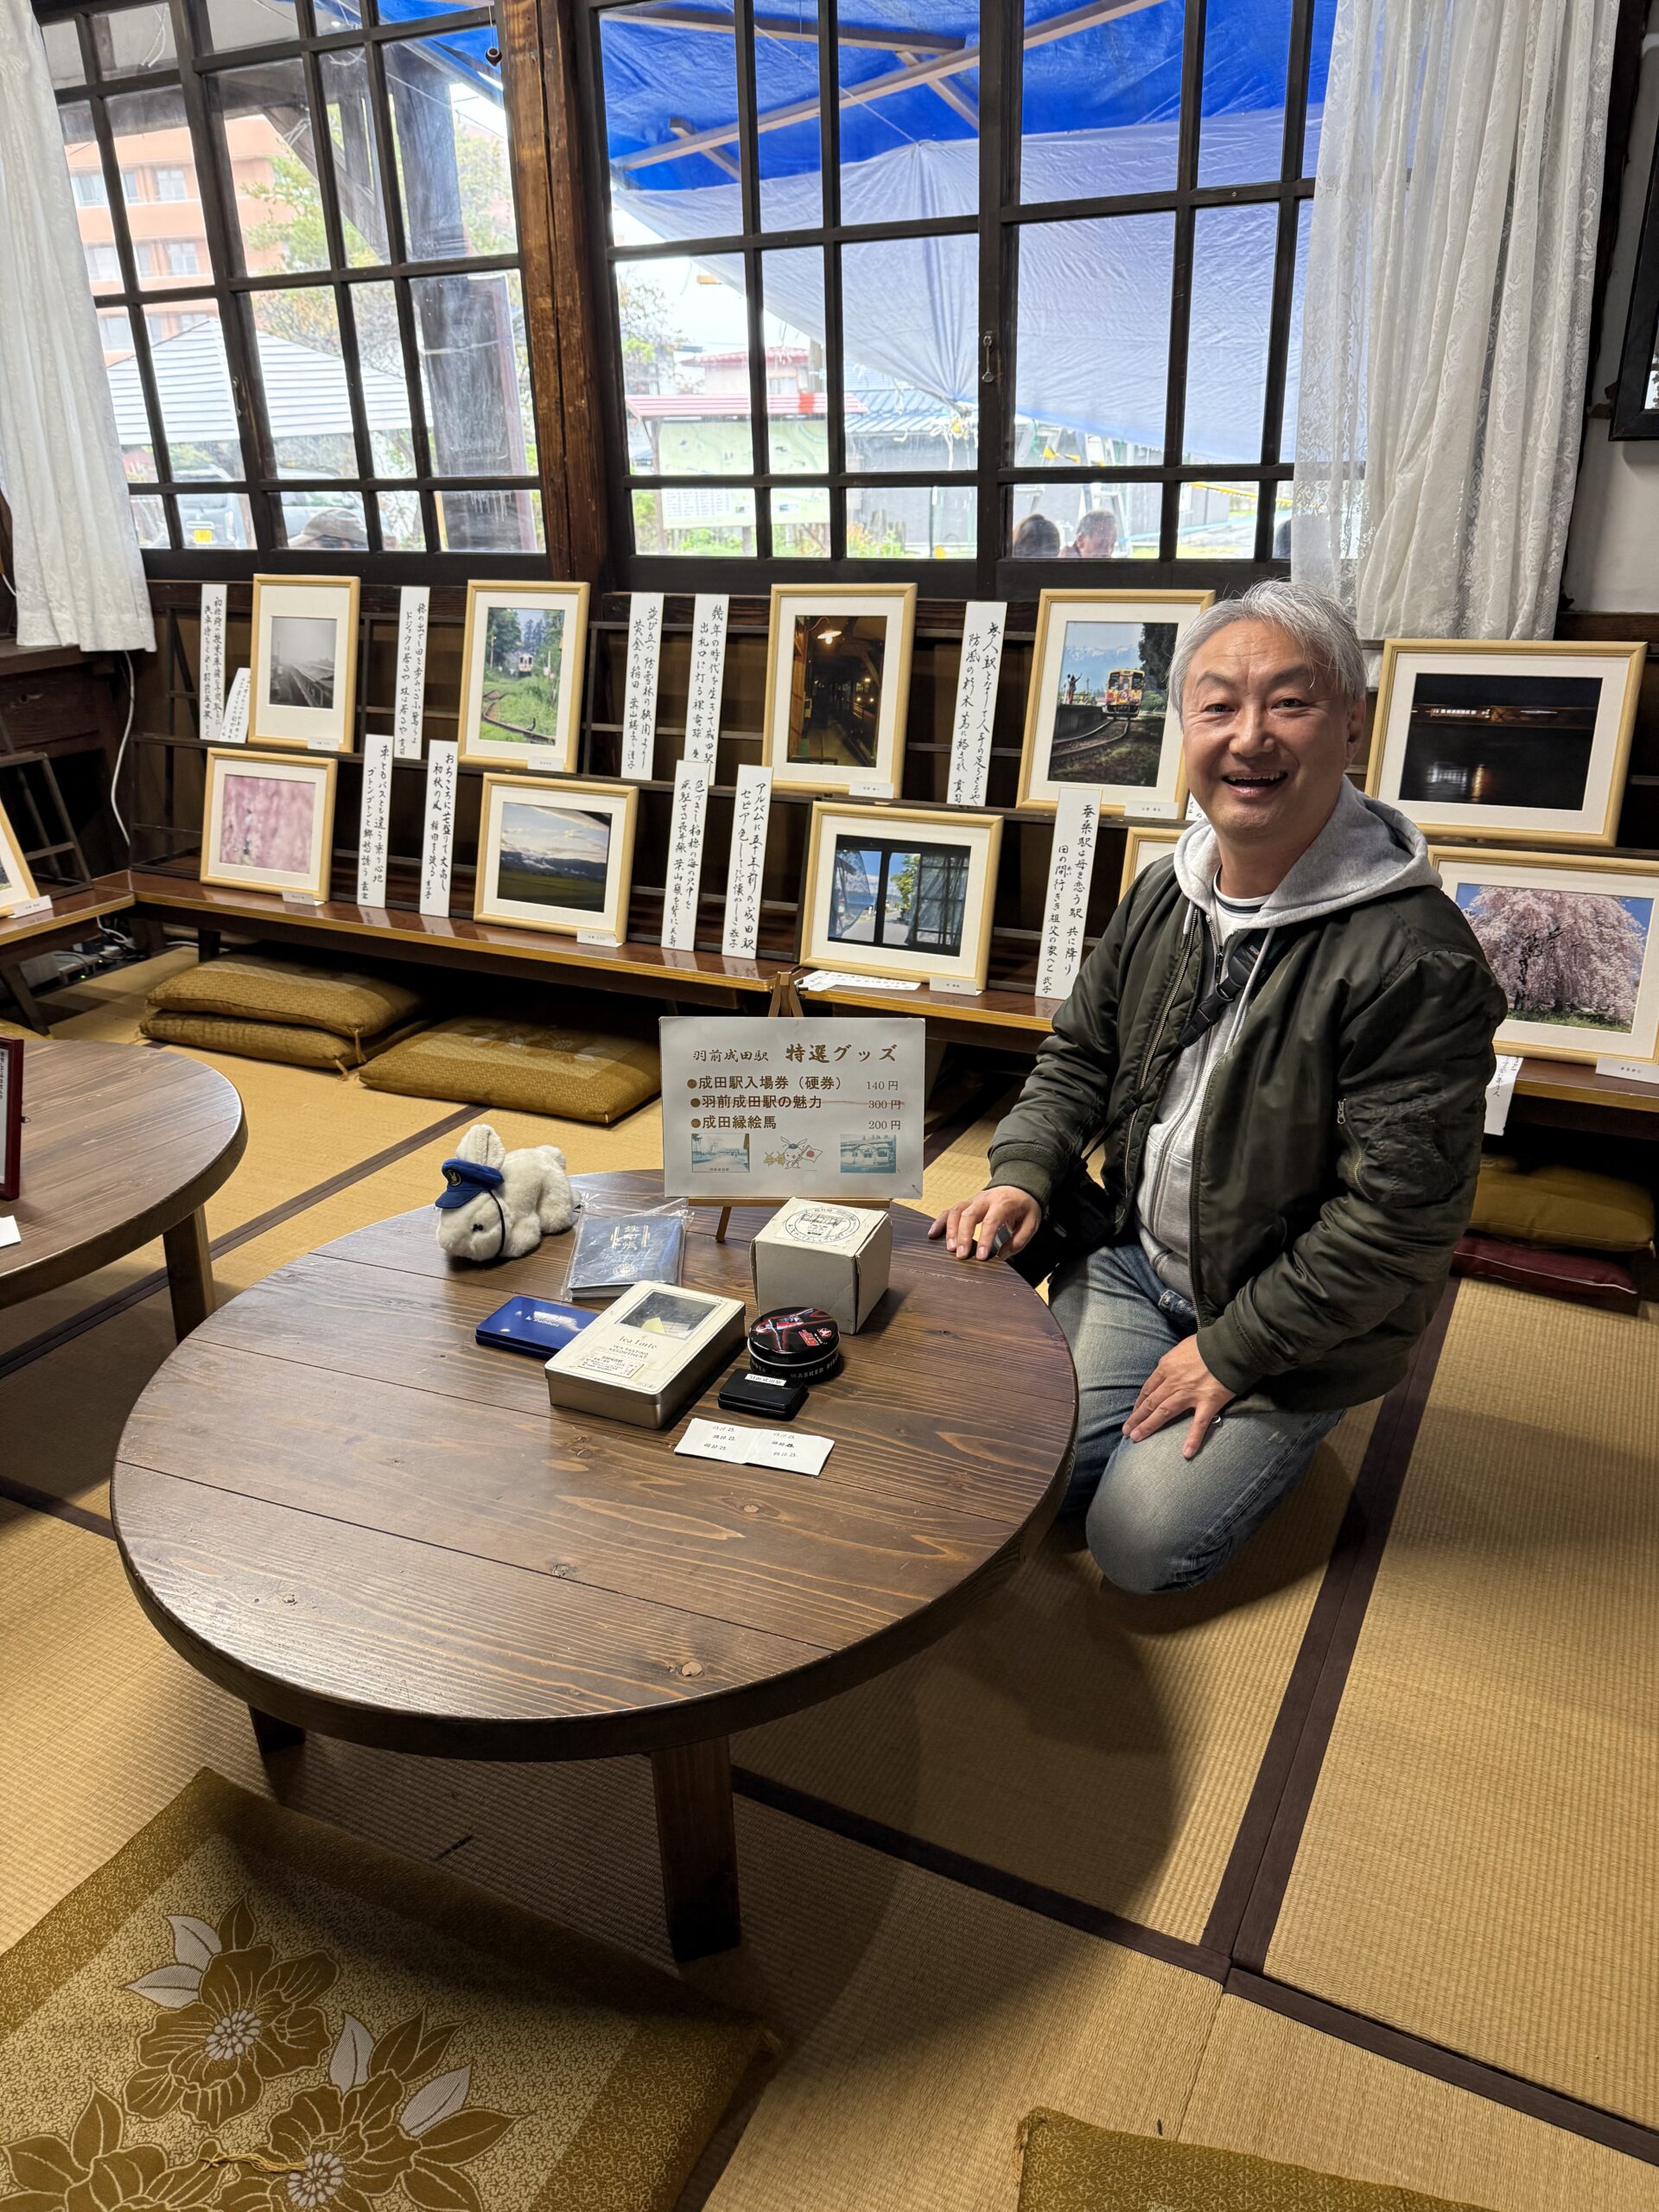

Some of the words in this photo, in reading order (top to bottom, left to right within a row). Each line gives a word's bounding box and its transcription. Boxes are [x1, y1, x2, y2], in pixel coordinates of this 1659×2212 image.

[692, 1048, 769, 1063] 羽前成田駅
[785, 1043, 898, 1064] 特選グッズ
[702, 1095, 823, 1109] 羽前成田駅の魅力
[702, 1116, 777, 1129] 成田縁絵馬
[790, 1368, 824, 1379] MASKED
